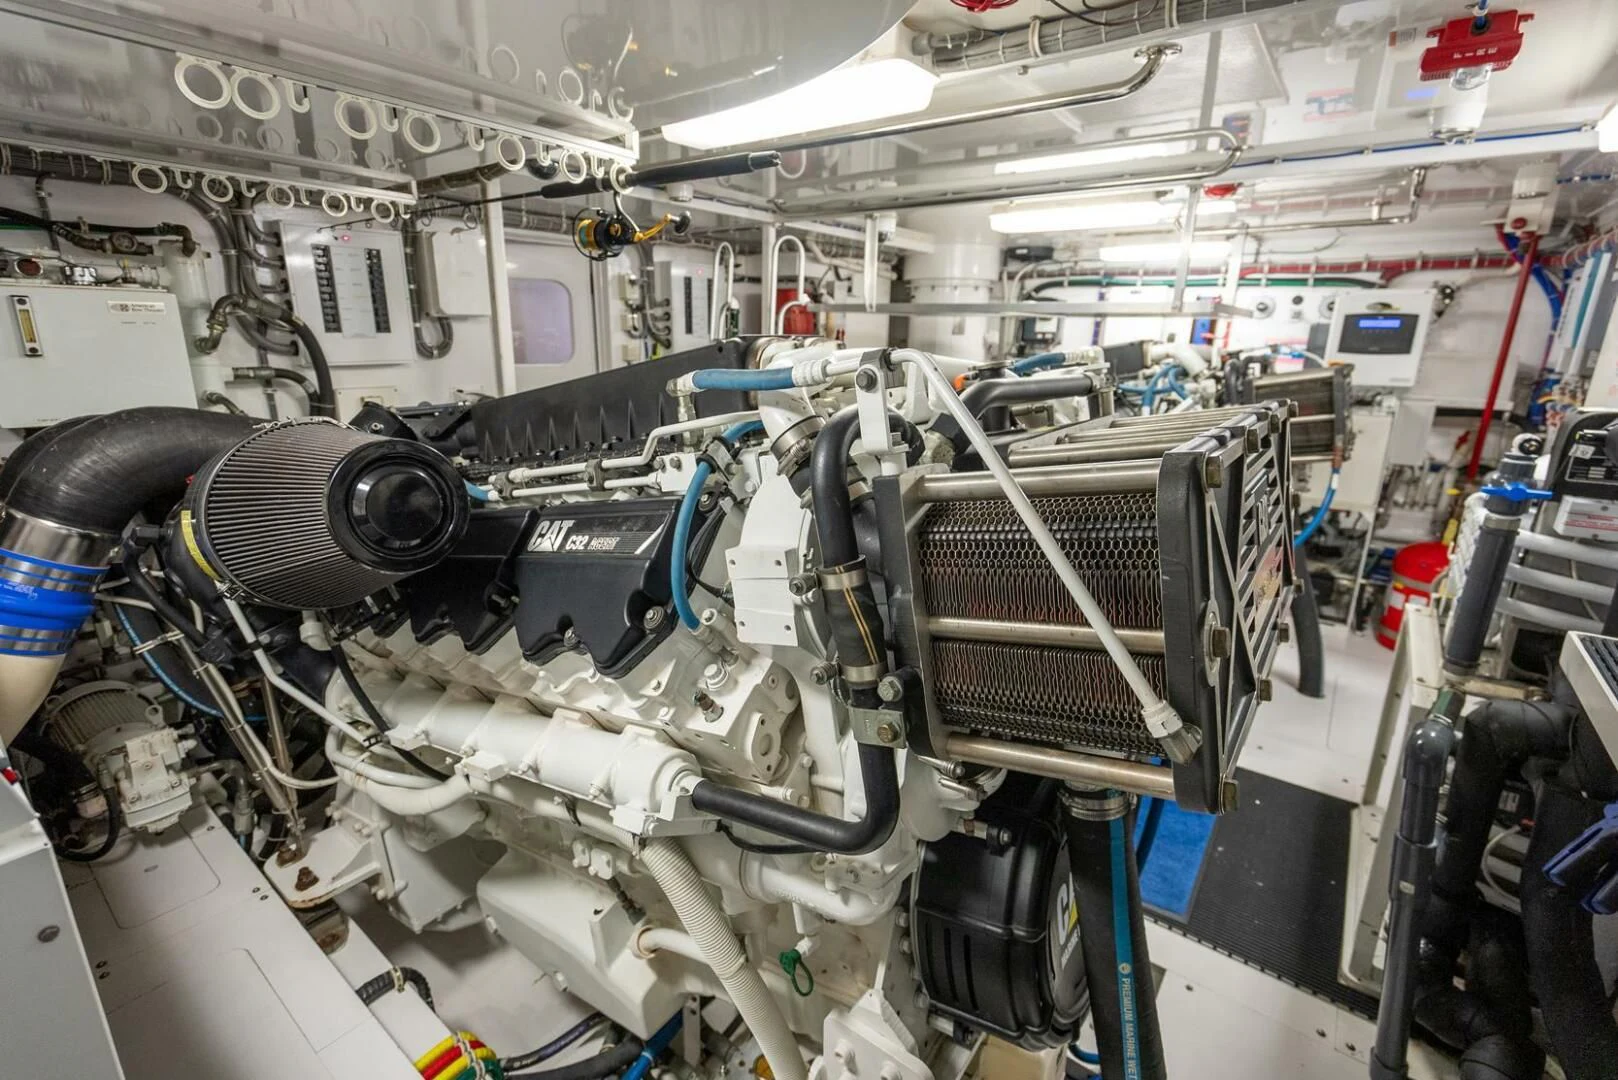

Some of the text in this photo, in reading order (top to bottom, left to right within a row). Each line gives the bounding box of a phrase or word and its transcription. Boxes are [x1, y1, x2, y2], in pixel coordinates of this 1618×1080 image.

[527, 520, 576, 552] CAT
[565, 535, 590, 550] C32
[1122, 977, 1133, 1021] PREMIUM
[1126, 1023, 1136, 1058] MARINE
